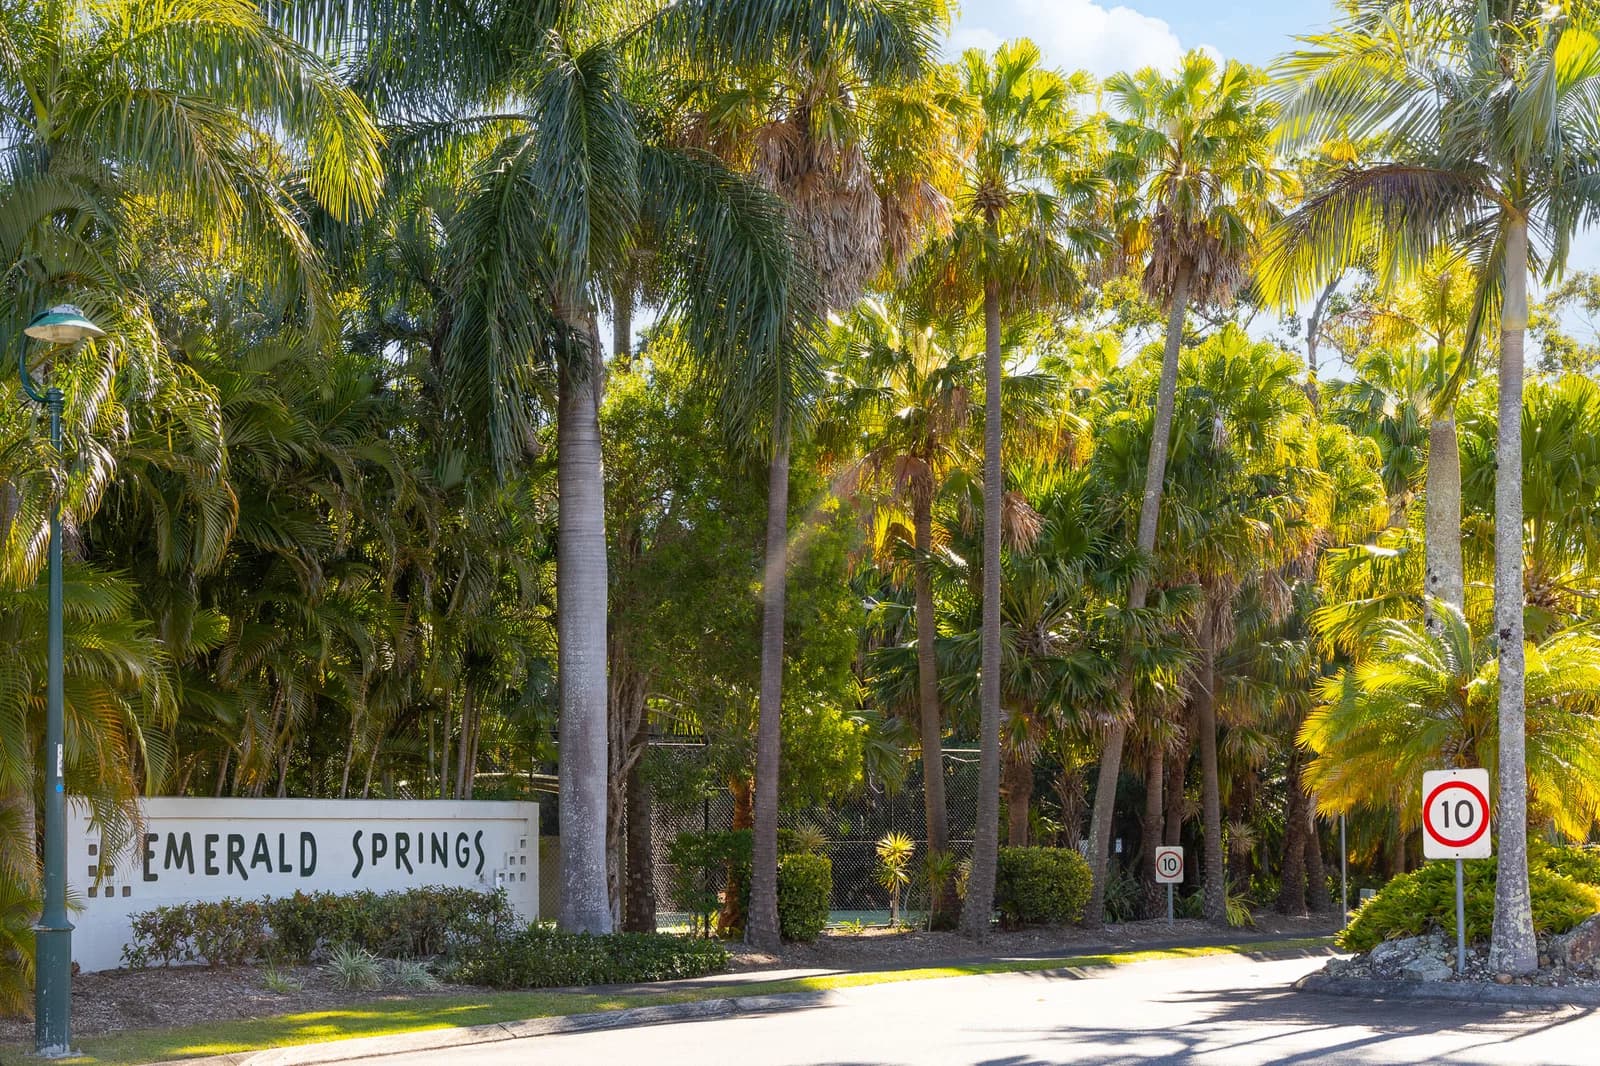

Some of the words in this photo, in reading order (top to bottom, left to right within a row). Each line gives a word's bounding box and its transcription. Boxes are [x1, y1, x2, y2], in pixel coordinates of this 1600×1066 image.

[1441, 800, 1474, 828] 10
[143, 831, 317, 882] EMERALD
[352, 829, 485, 879] SPRINGS
[1163, 858, 1177, 871] 10
